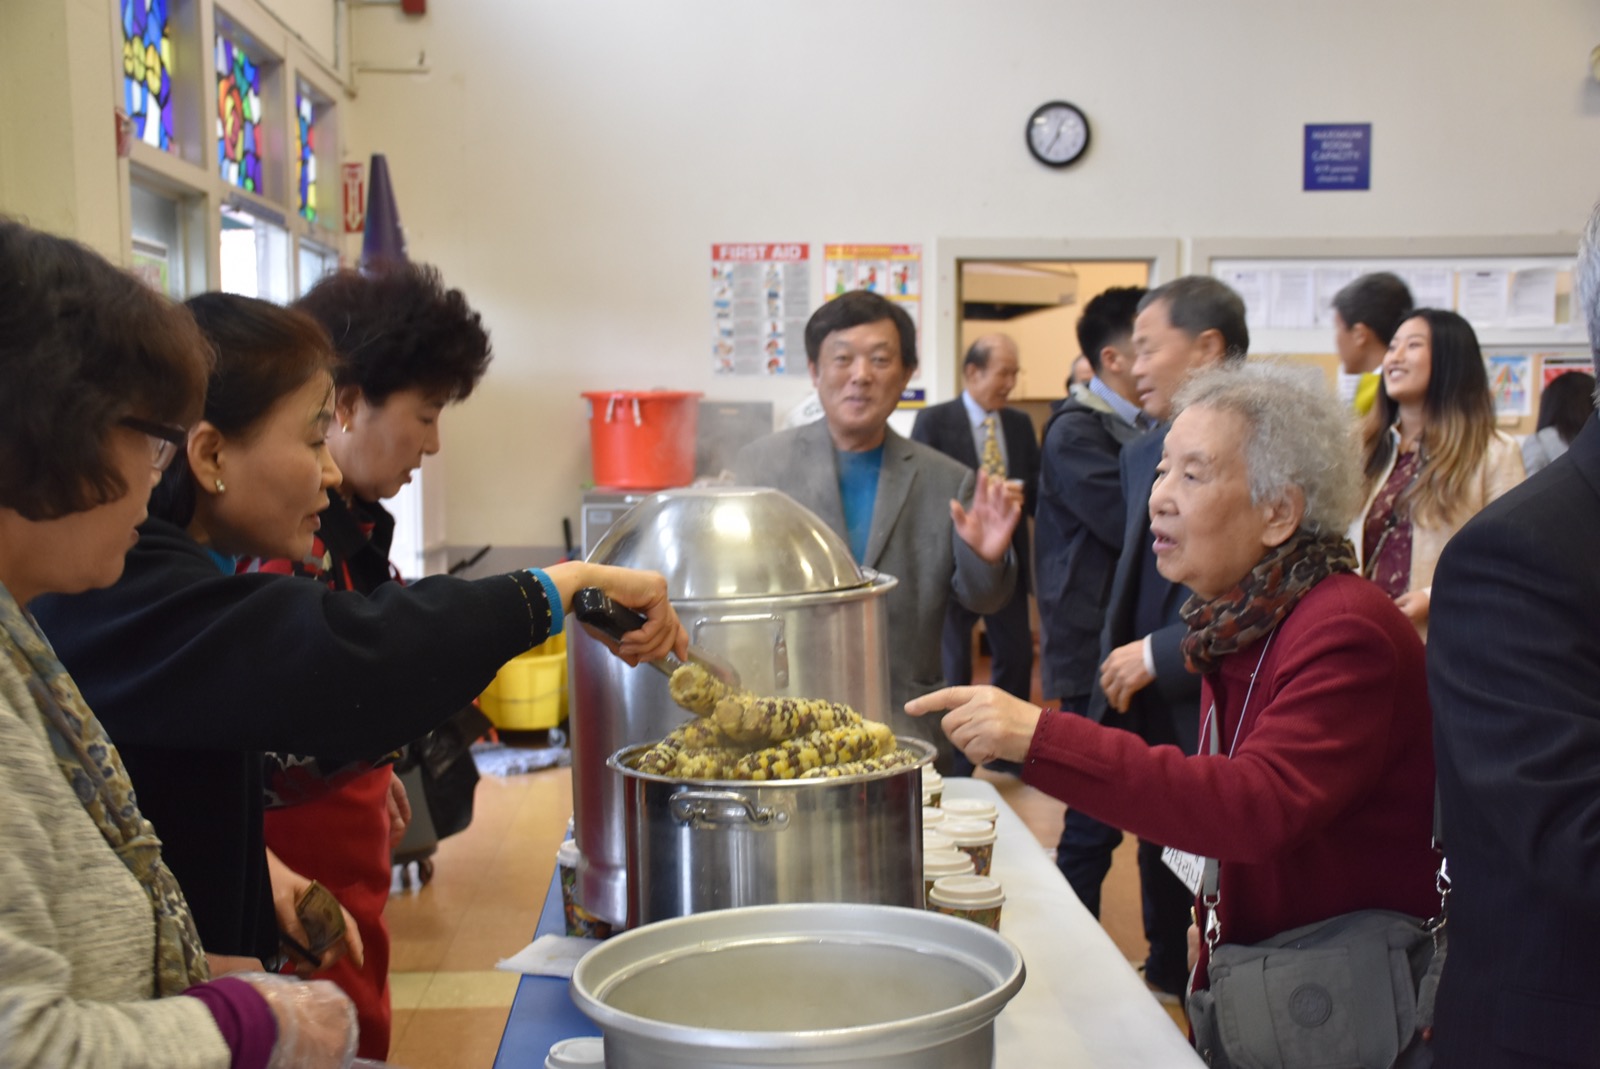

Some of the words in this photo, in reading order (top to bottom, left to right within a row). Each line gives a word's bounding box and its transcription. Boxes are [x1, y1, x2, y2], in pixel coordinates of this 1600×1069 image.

[1311, 130, 1363, 139] MAXIMUM
[1321, 141, 1353, 149] ROOM
[1311, 151, 1361, 161] CAPACITY
[720, 244, 767, 260] FIRST
[772, 244, 801, 260] AID
